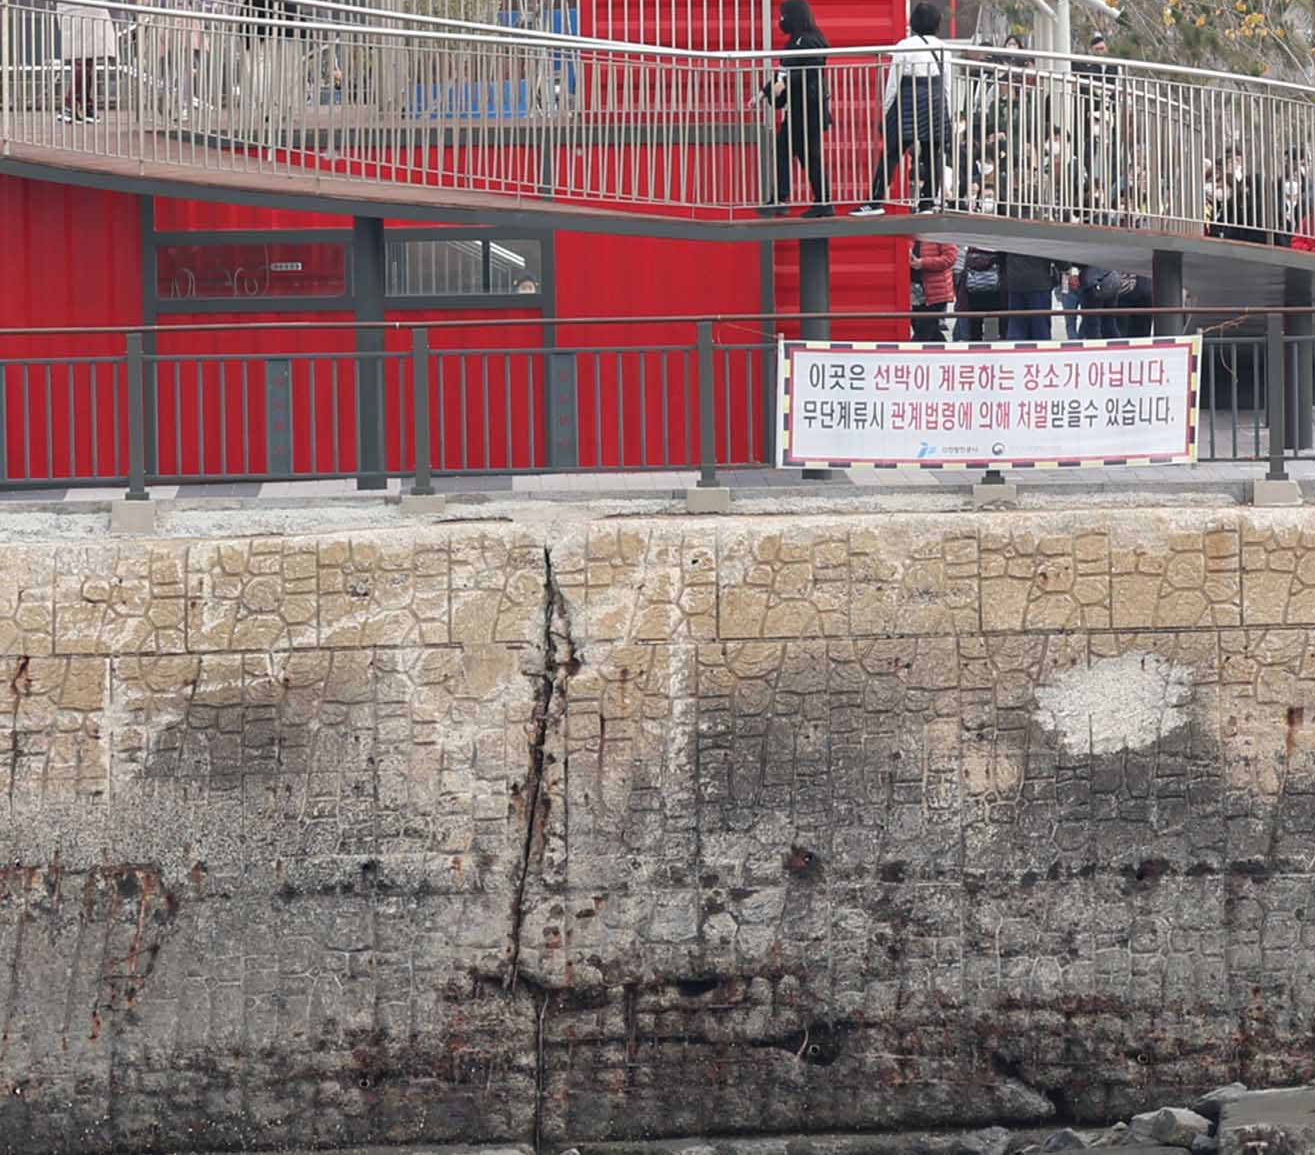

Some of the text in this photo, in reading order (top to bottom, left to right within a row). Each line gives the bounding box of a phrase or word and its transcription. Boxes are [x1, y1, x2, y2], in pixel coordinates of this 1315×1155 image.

[809, 359, 1170, 391] 이곳은 선박이 계류하는 장소가 아닙니다.
[803, 396, 1175, 431] 무단계류시 관계법령에 의해 처벌받을수 있습니다.
